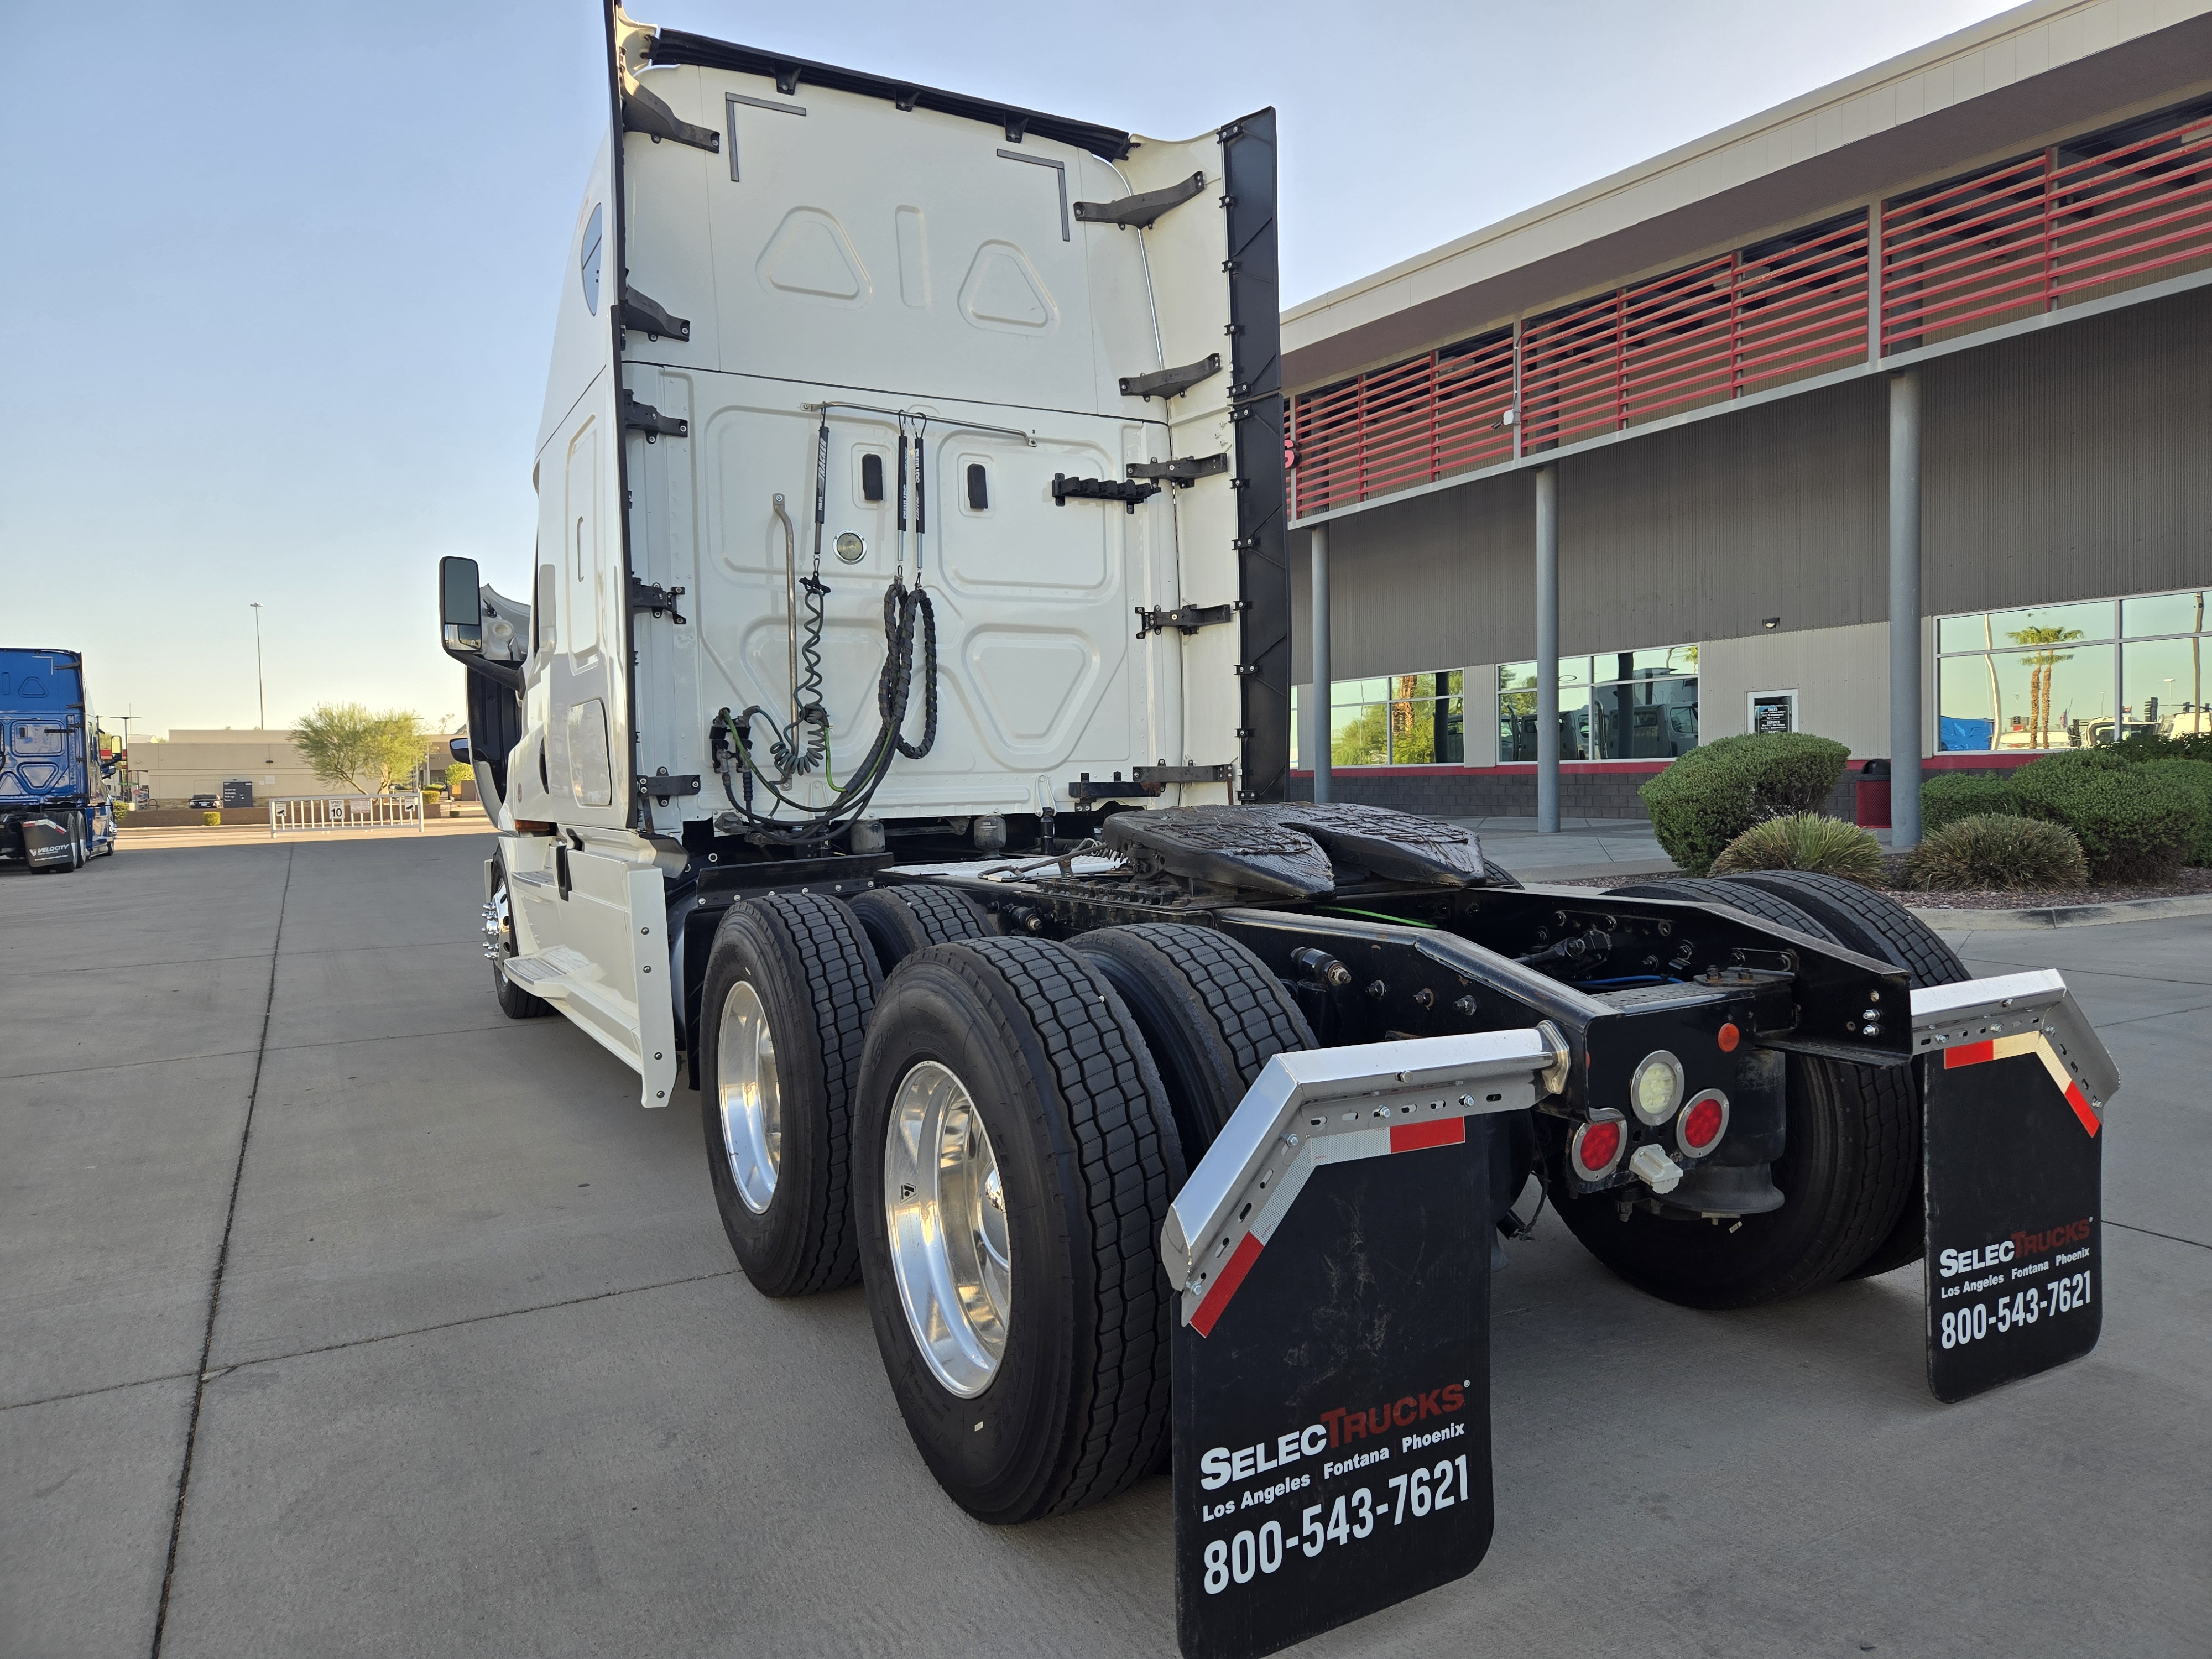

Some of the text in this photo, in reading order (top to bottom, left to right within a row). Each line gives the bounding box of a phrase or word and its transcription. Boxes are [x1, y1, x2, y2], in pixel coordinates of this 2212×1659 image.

[818, 437, 827, 481] TRACKER
[331, 808, 342, 817] 10
[38, 844, 69, 853] VELOCITY
[1941, 1246, 2090, 1298] Los Angeles Fontana Phoenix
[1941, 1270, 2091, 1349] 800-543-7621
[1202, 1422, 1465, 1522] Los Angeles Fontana Phoenix
[1203, 1454, 1469, 1595] 800-543-7621
